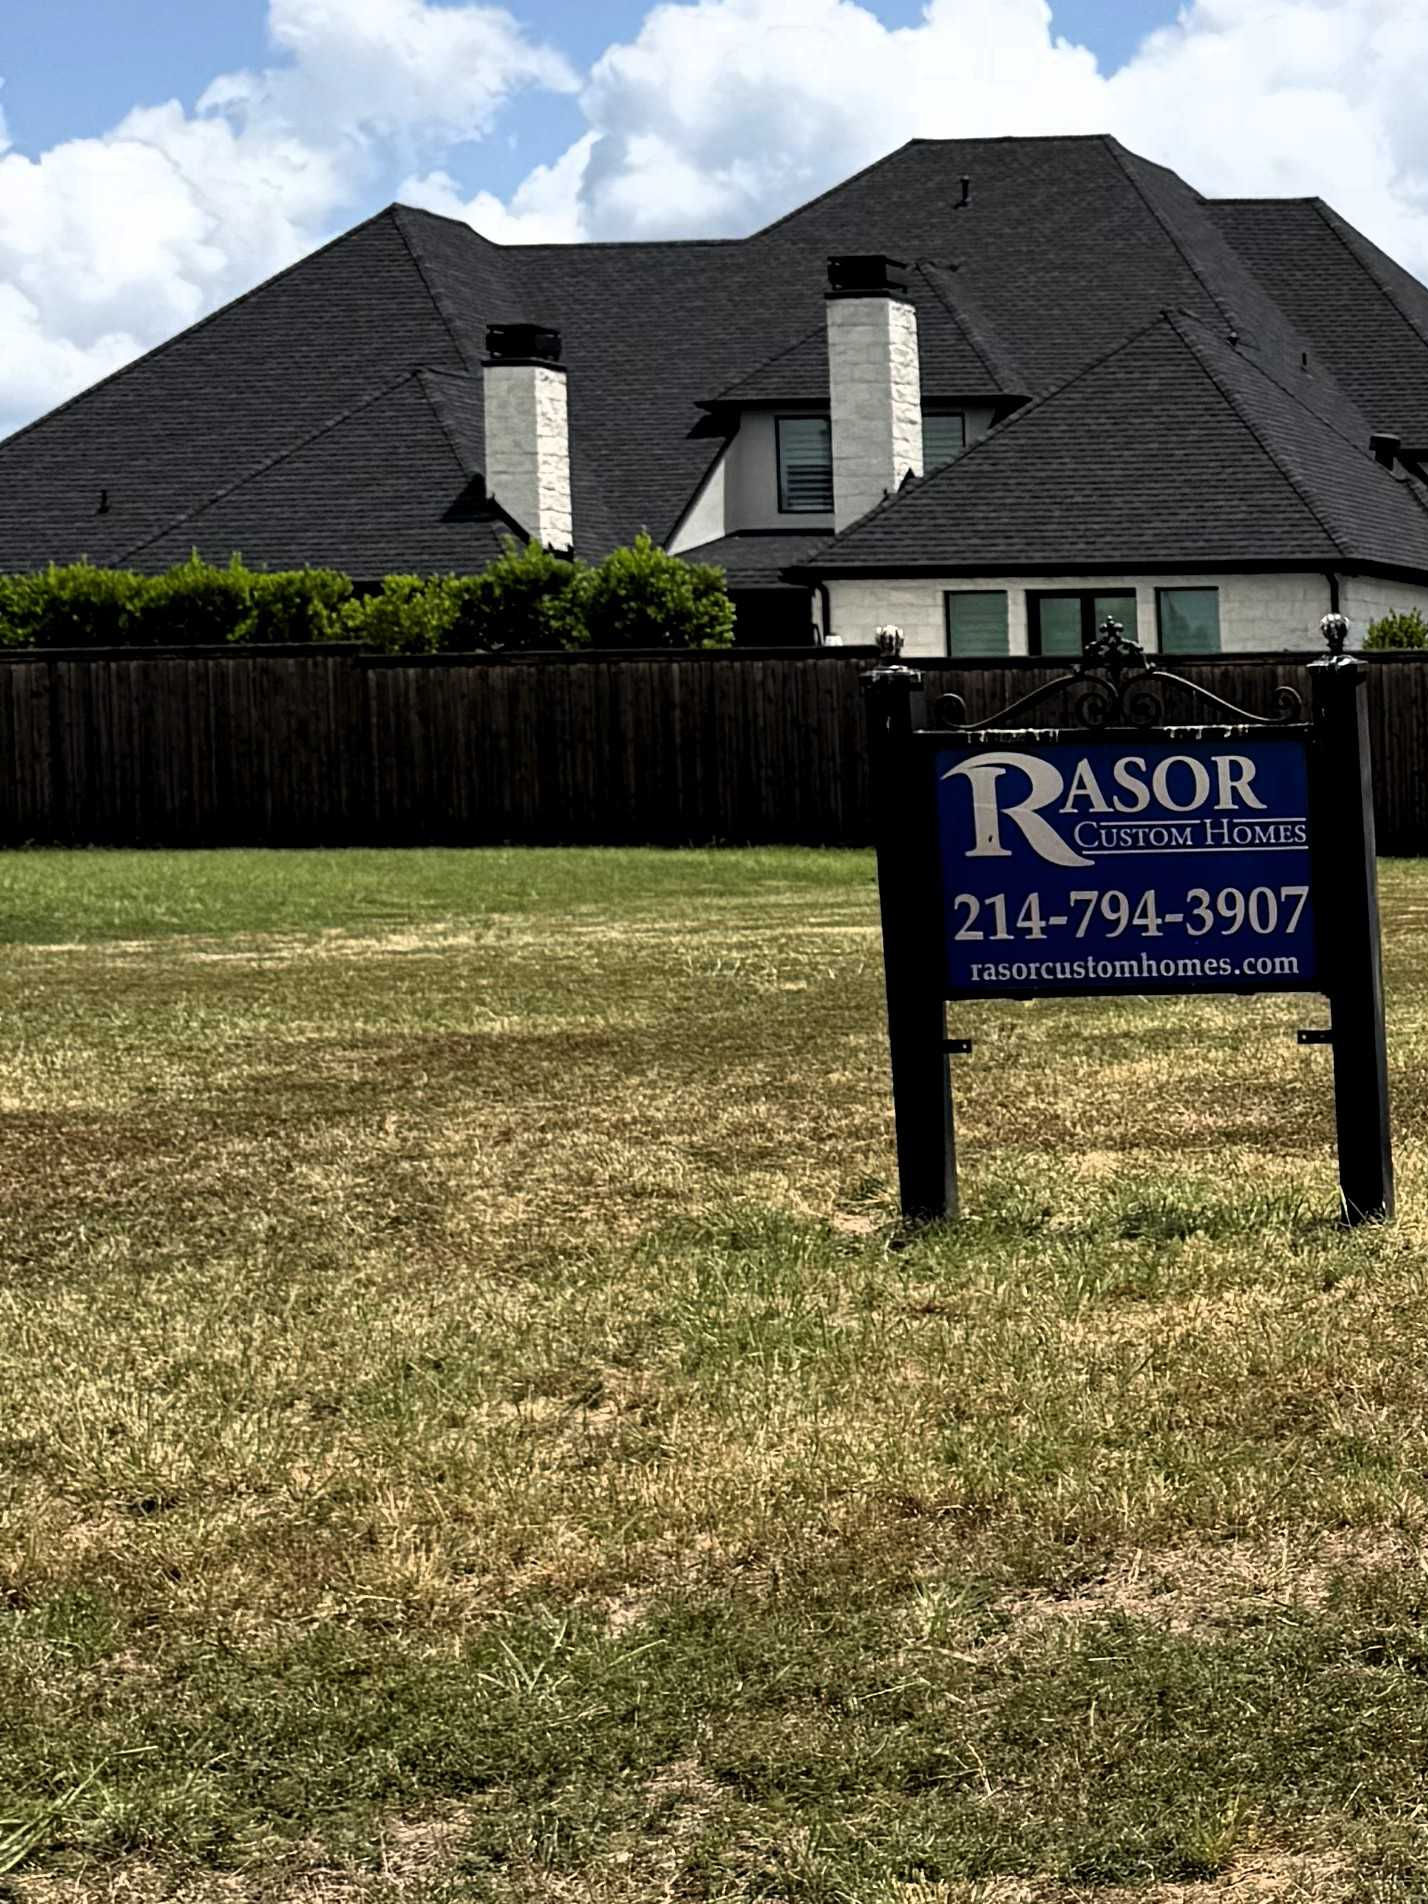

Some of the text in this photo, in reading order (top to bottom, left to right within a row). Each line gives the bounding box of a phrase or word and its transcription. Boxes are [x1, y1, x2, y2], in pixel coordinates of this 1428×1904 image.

[940, 752, 1267, 866] RASOR
[1074, 819, 1307, 848] CUSTOM HOMES
[954, 886, 1309, 940] 214-794-3907
[970, 953, 1299, 981] rasorcustomhomes.com
